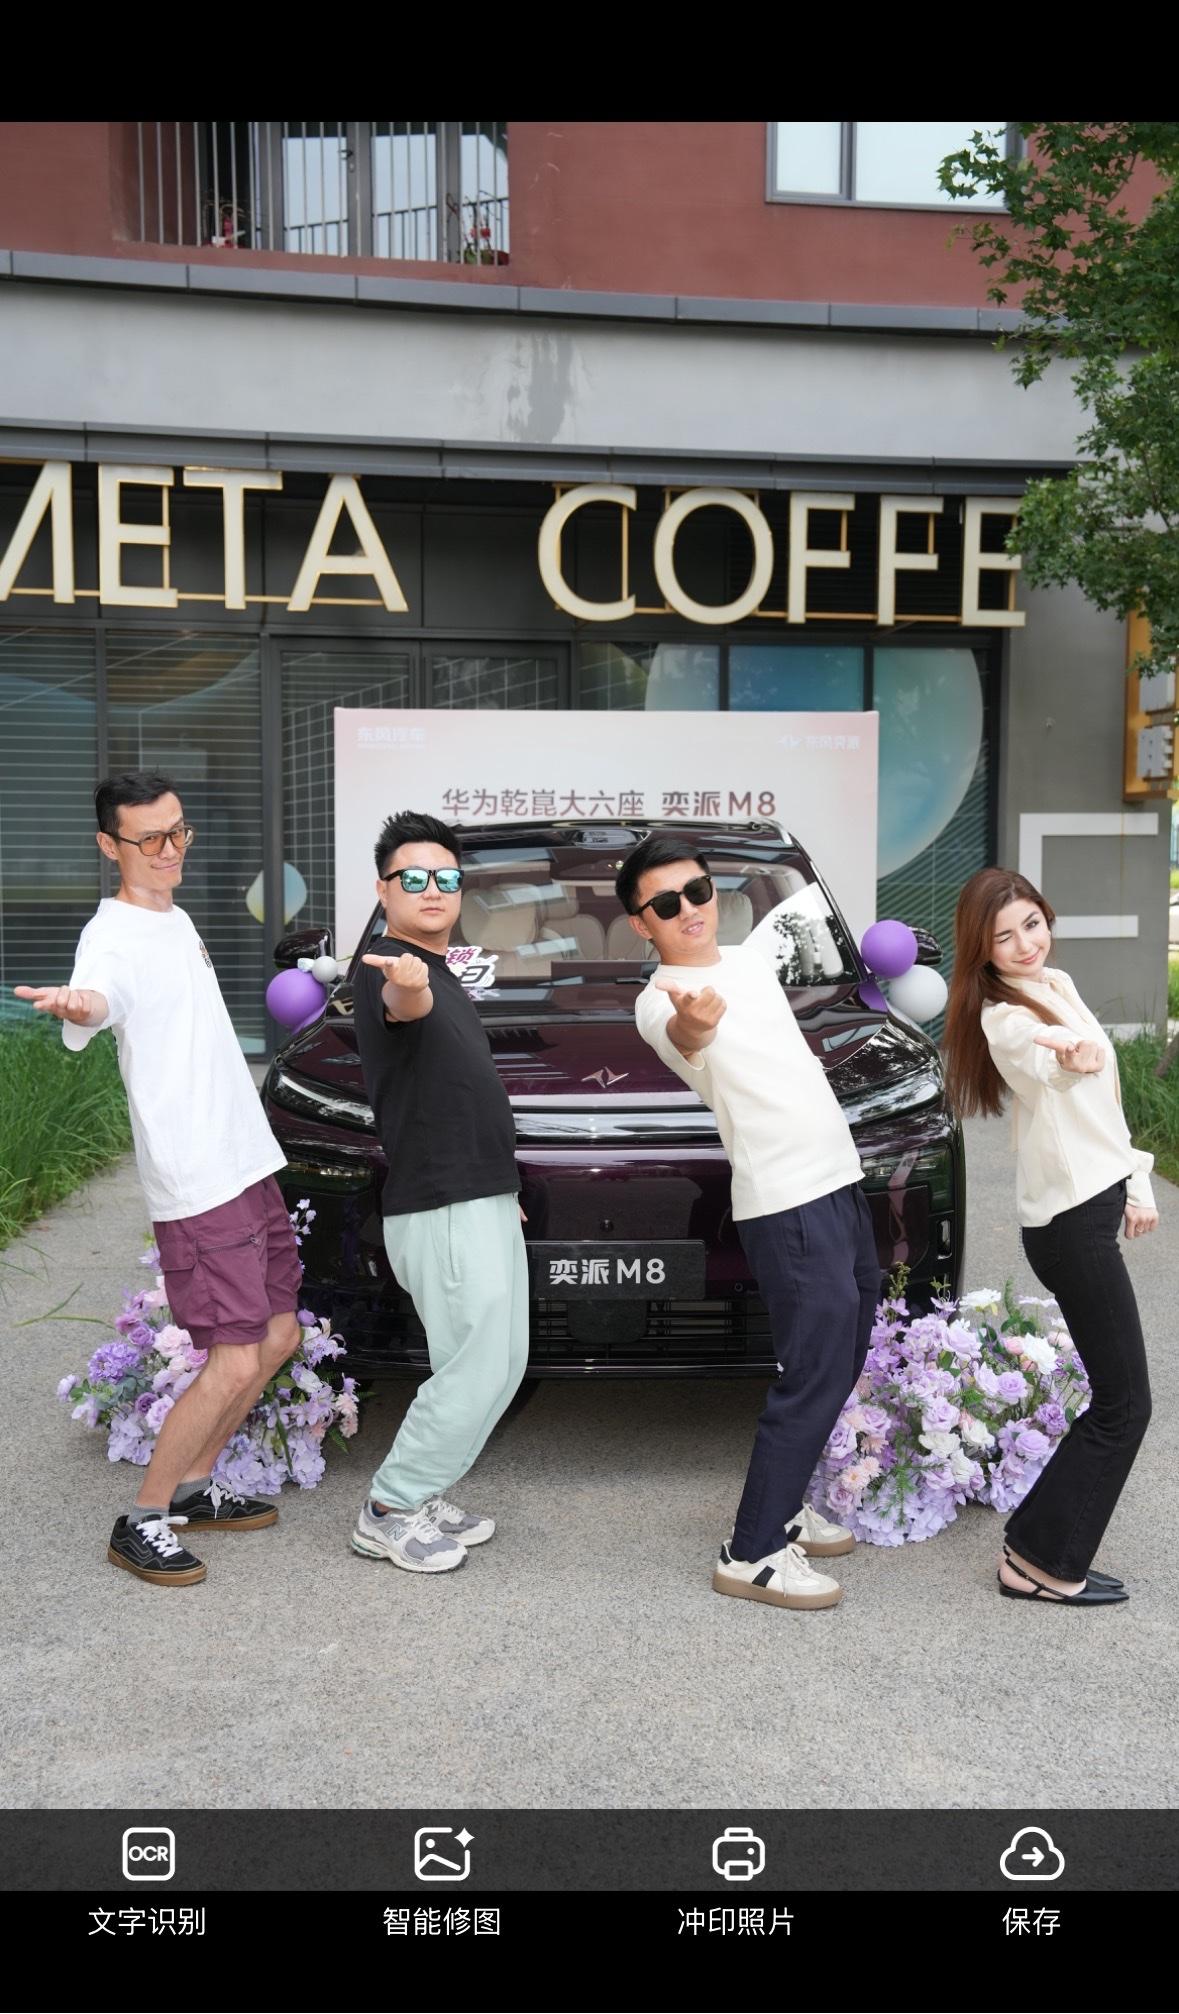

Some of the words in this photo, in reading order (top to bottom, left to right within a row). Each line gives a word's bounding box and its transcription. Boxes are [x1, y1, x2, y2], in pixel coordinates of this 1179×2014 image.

[538, 485, 1026, 627] COFFE
[442, 788, 645, 817] 华为乾崑大六座
